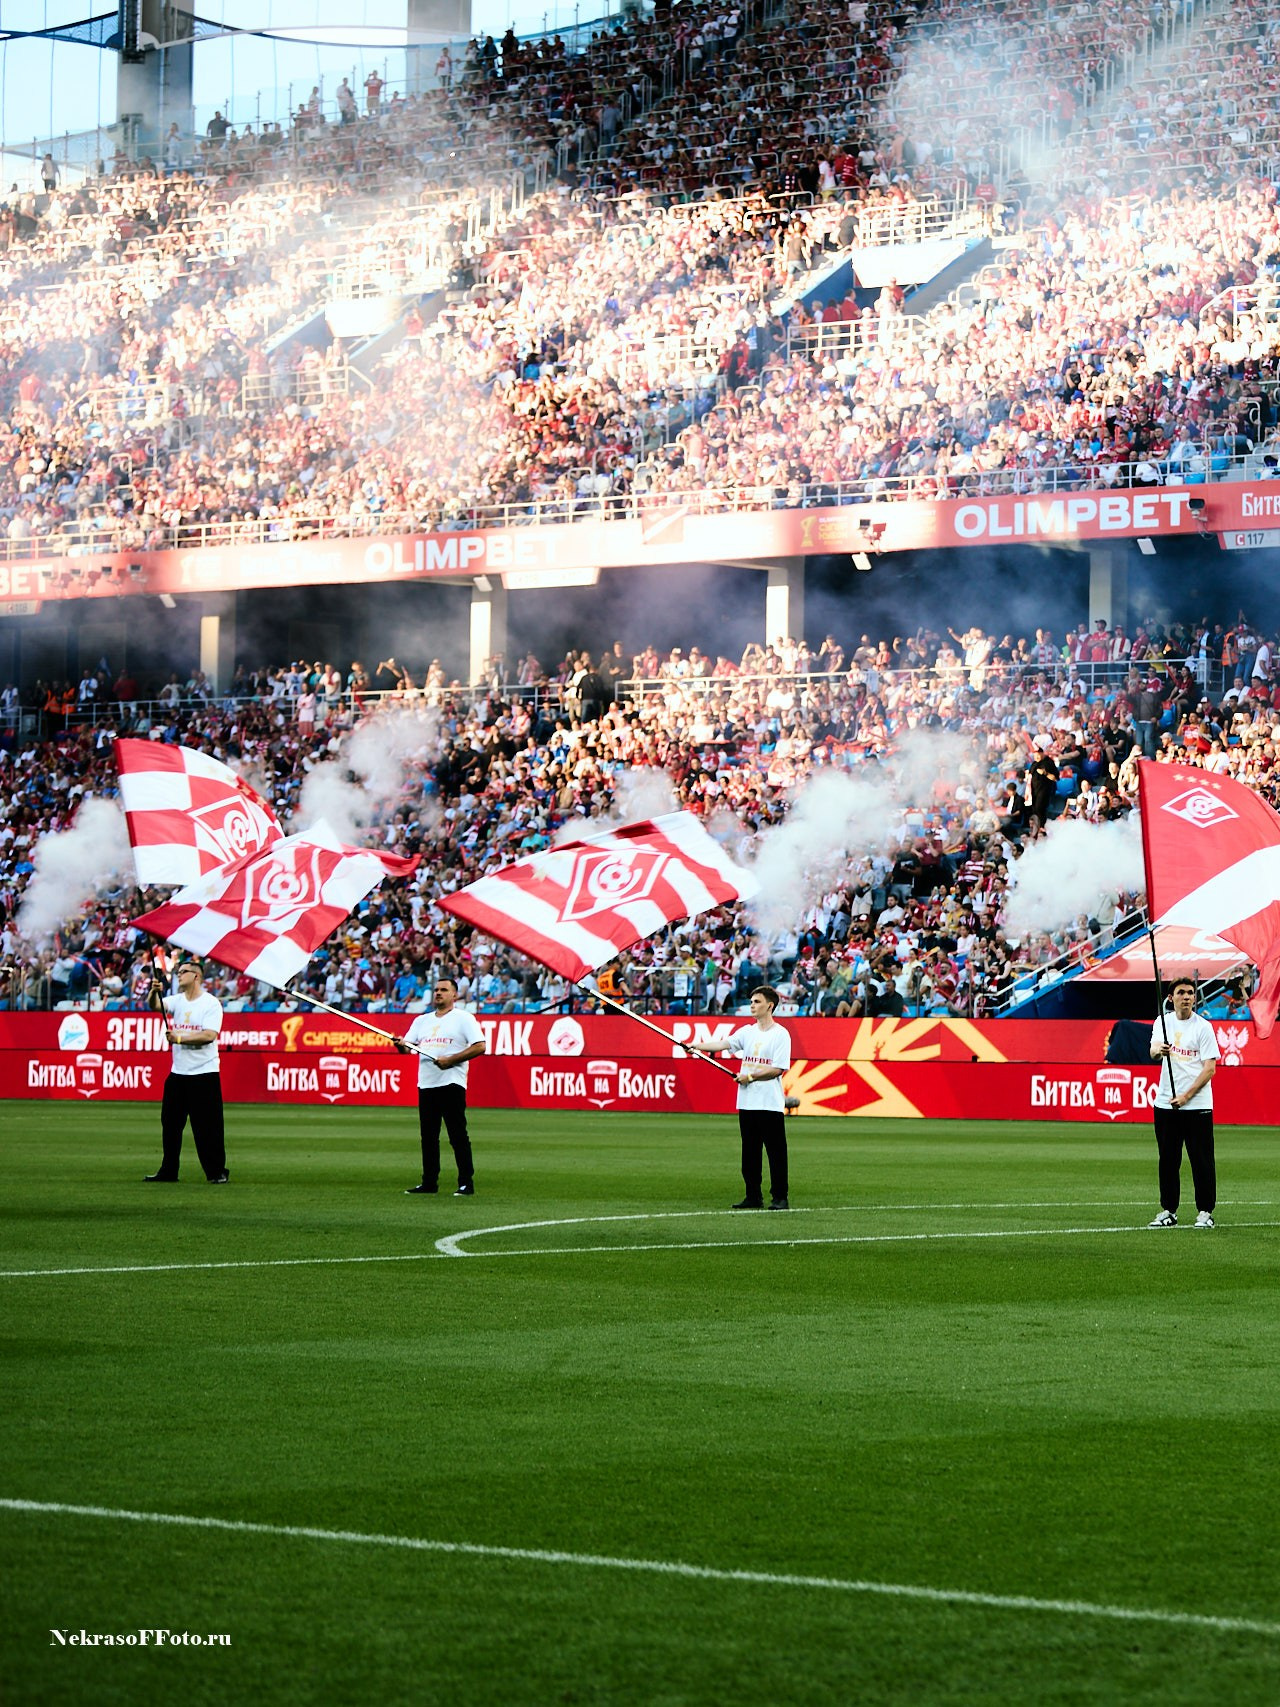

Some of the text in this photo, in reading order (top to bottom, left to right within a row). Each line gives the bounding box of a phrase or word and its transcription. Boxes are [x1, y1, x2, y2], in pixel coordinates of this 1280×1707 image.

[953, 492, 1191, 539] OLIMPBET
[364, 530, 564, 574] OLIMPBET
[1247, 532, 1265, 545] 117
[106, 1017, 170, 1052] ЗЕНИ
[672, 1022, 744, 1059] RM
